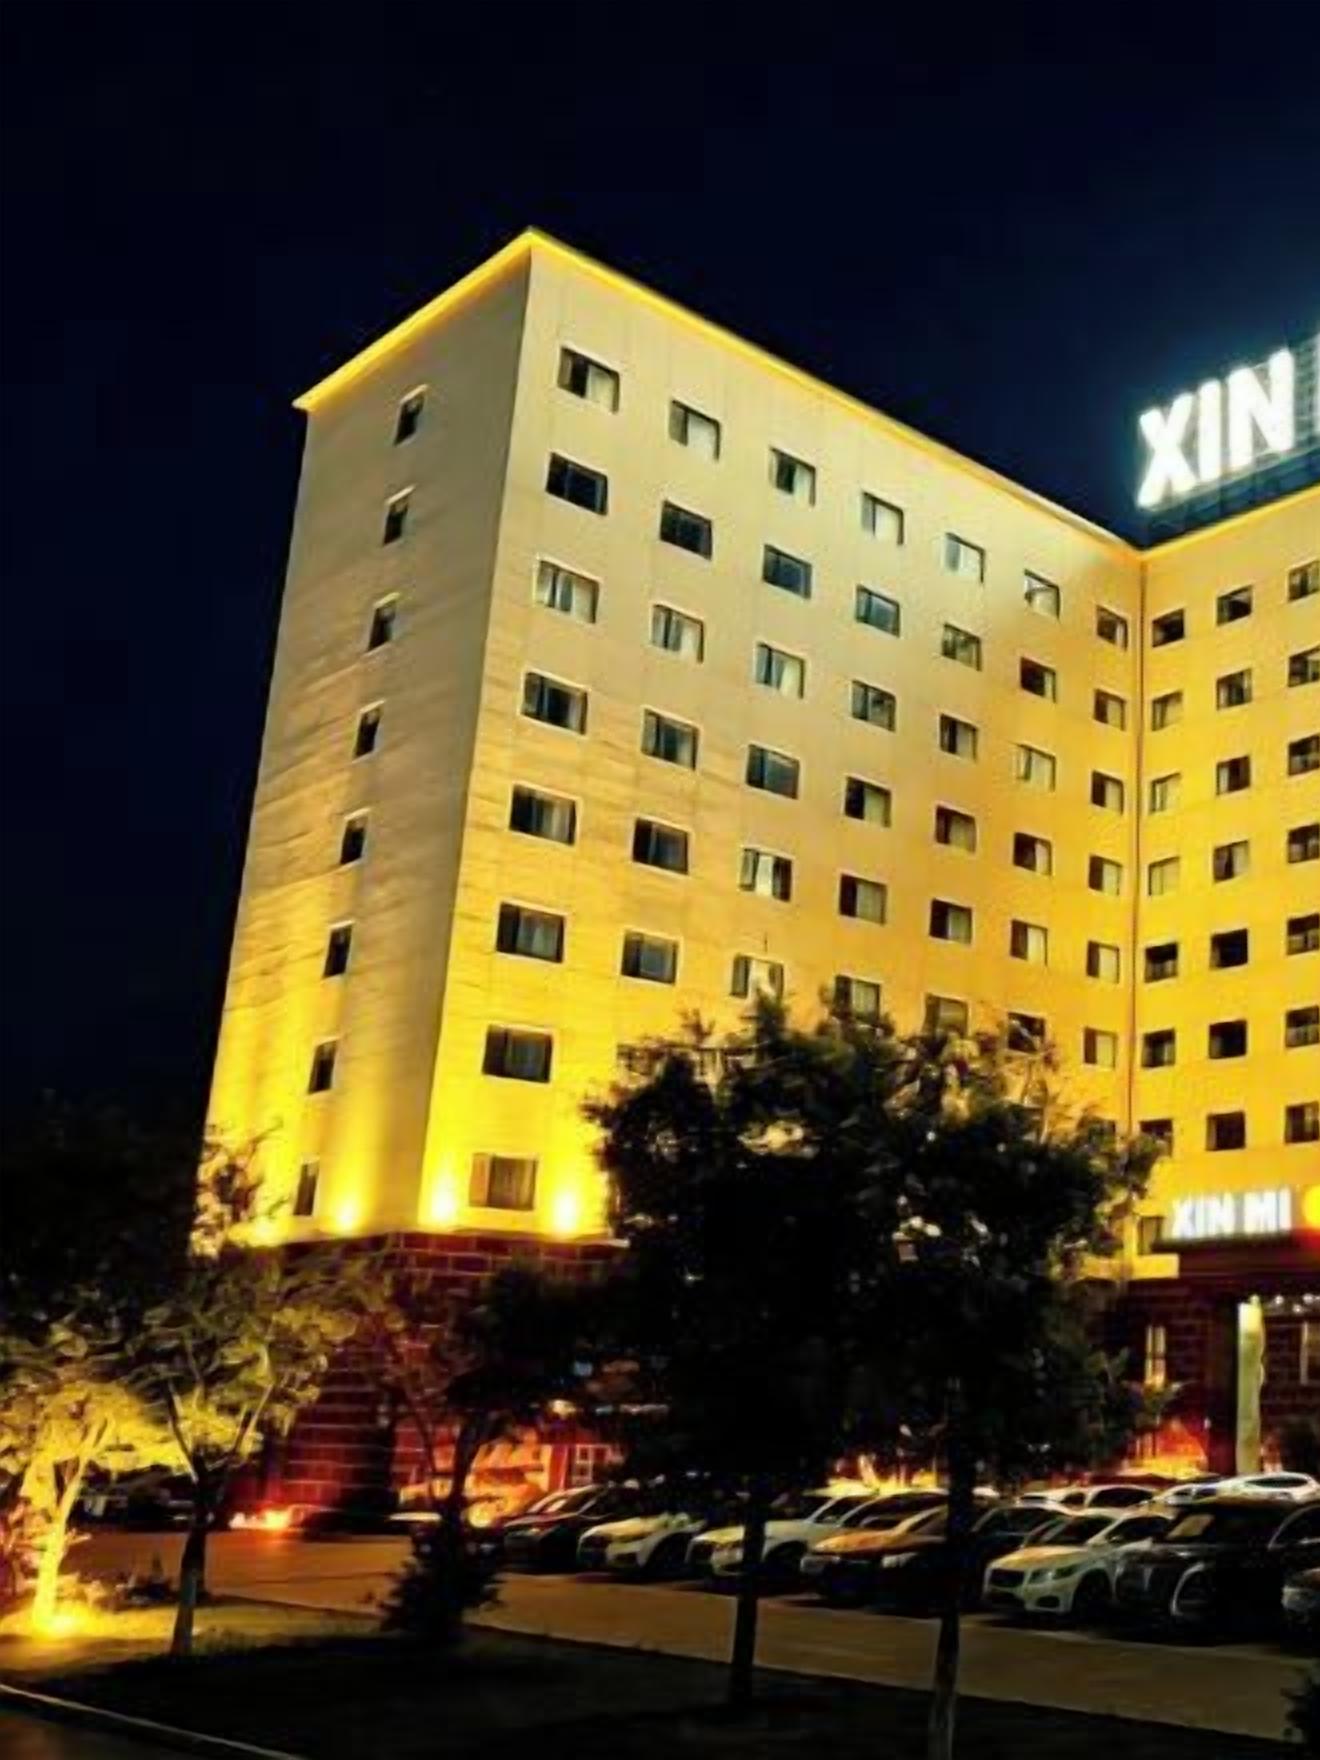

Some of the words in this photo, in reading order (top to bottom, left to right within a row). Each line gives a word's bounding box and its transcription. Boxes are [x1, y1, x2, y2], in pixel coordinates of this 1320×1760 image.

[1136, 349, 1294, 509] XIN
[1171, 1194, 1235, 1239] XIN
[1243, 1187, 1291, 1232] MI
